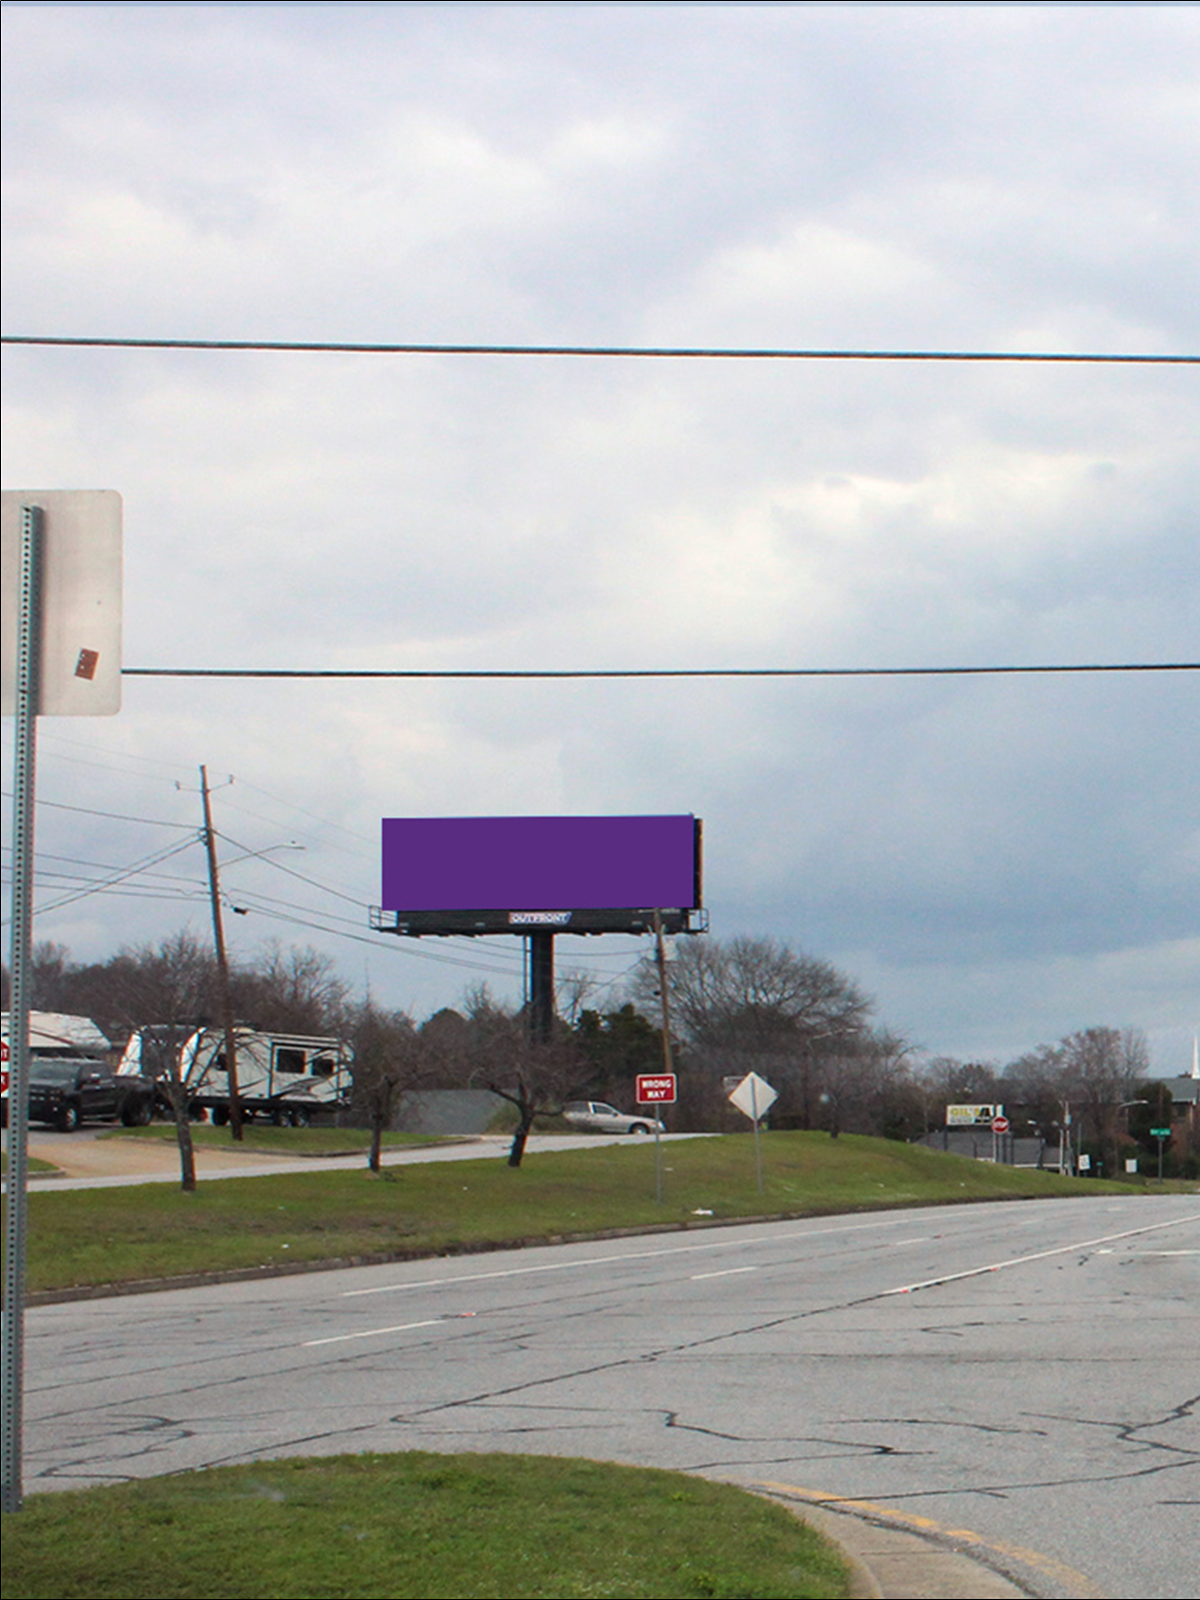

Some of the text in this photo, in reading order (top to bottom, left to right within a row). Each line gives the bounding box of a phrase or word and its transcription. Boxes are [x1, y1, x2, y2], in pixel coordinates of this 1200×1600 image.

[511, 912, 568, 923] OUTFRONT
[641, 1079, 672, 1089] WRONG
[647, 1090, 666, 1099] WAY
[992, 1120, 1009, 1128] STOP
